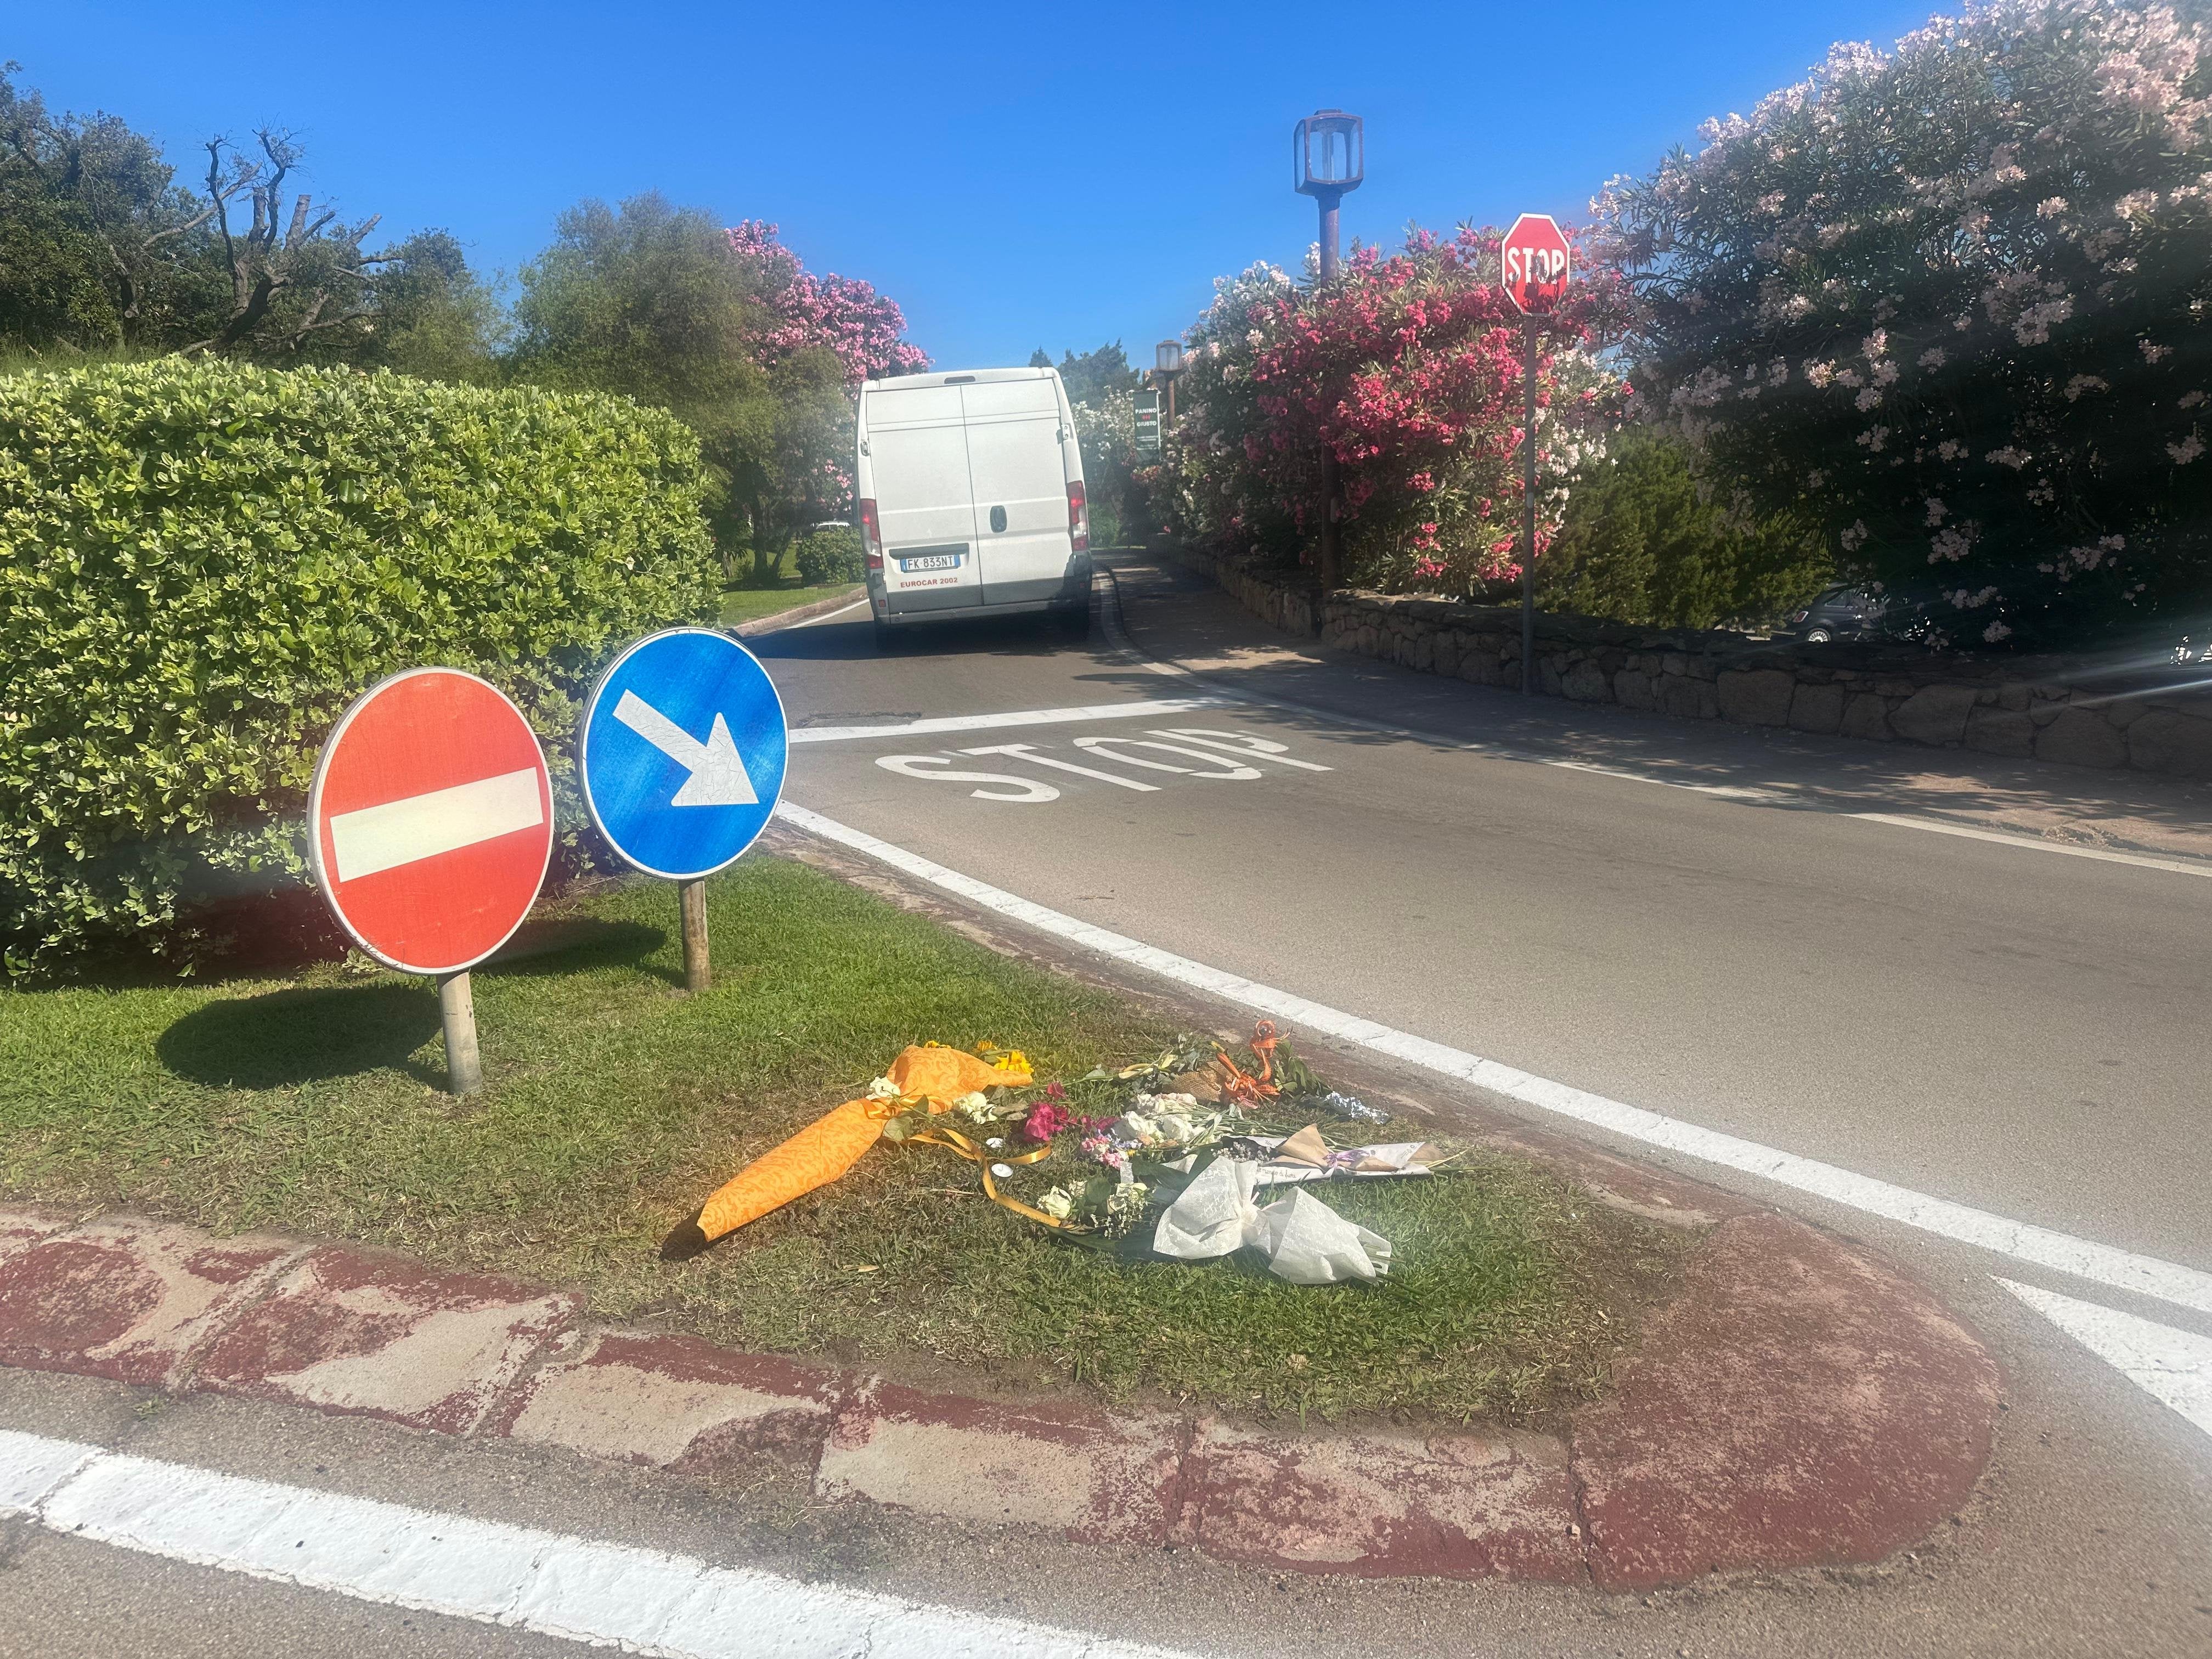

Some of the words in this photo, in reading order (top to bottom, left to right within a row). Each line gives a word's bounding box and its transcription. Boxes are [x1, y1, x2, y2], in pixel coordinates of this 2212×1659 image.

[1507, 247, 1565, 284] STOP
[907, 558, 919, 569] FK
[923, 556, 953, 568] 833NT
[900, 579, 938, 588] EUROCAR
[875, 729, 1335, 802] STOP
